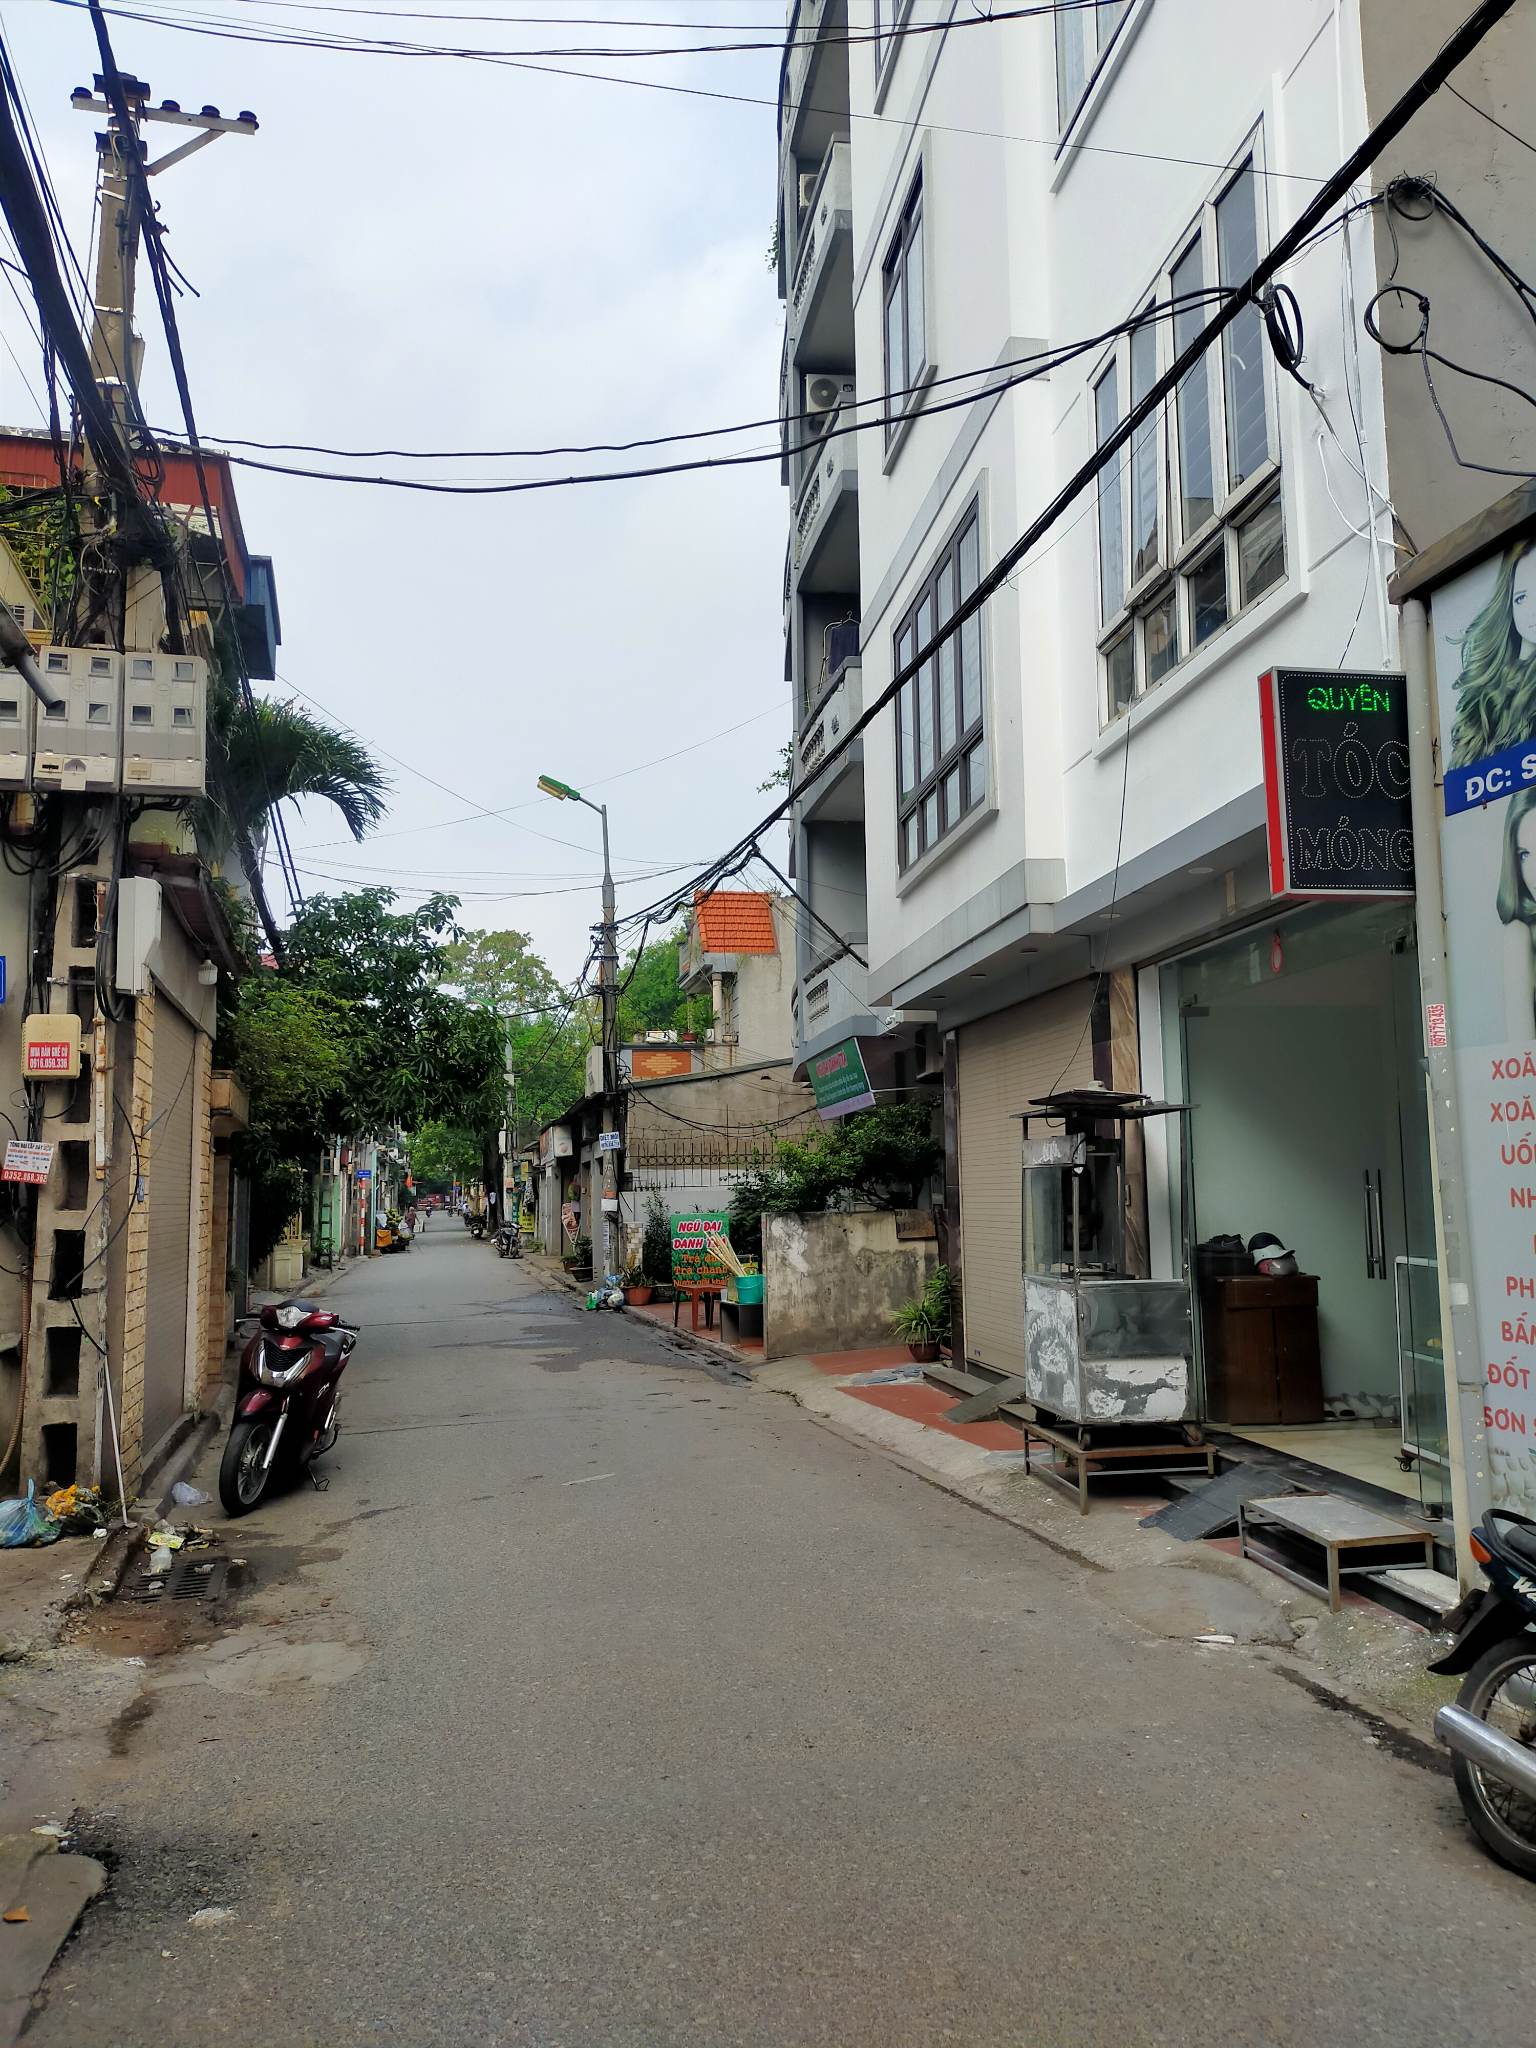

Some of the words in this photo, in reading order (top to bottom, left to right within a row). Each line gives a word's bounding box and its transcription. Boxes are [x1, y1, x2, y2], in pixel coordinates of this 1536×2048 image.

[1307, 683, 1391, 713] QUYÊN
[1292, 721, 1410, 800] TÓC
[1464, 767, 1512, 802] ĐC:
[1296, 815, 1414, 871] MÓNG
[1501, 1132, 1536, 1165] UỐ
[673, 1237, 704, 1250] DANH
[1487, 1356, 1530, 1390] ĐỐT
[1483, 1406, 1526, 1435] SƠN
